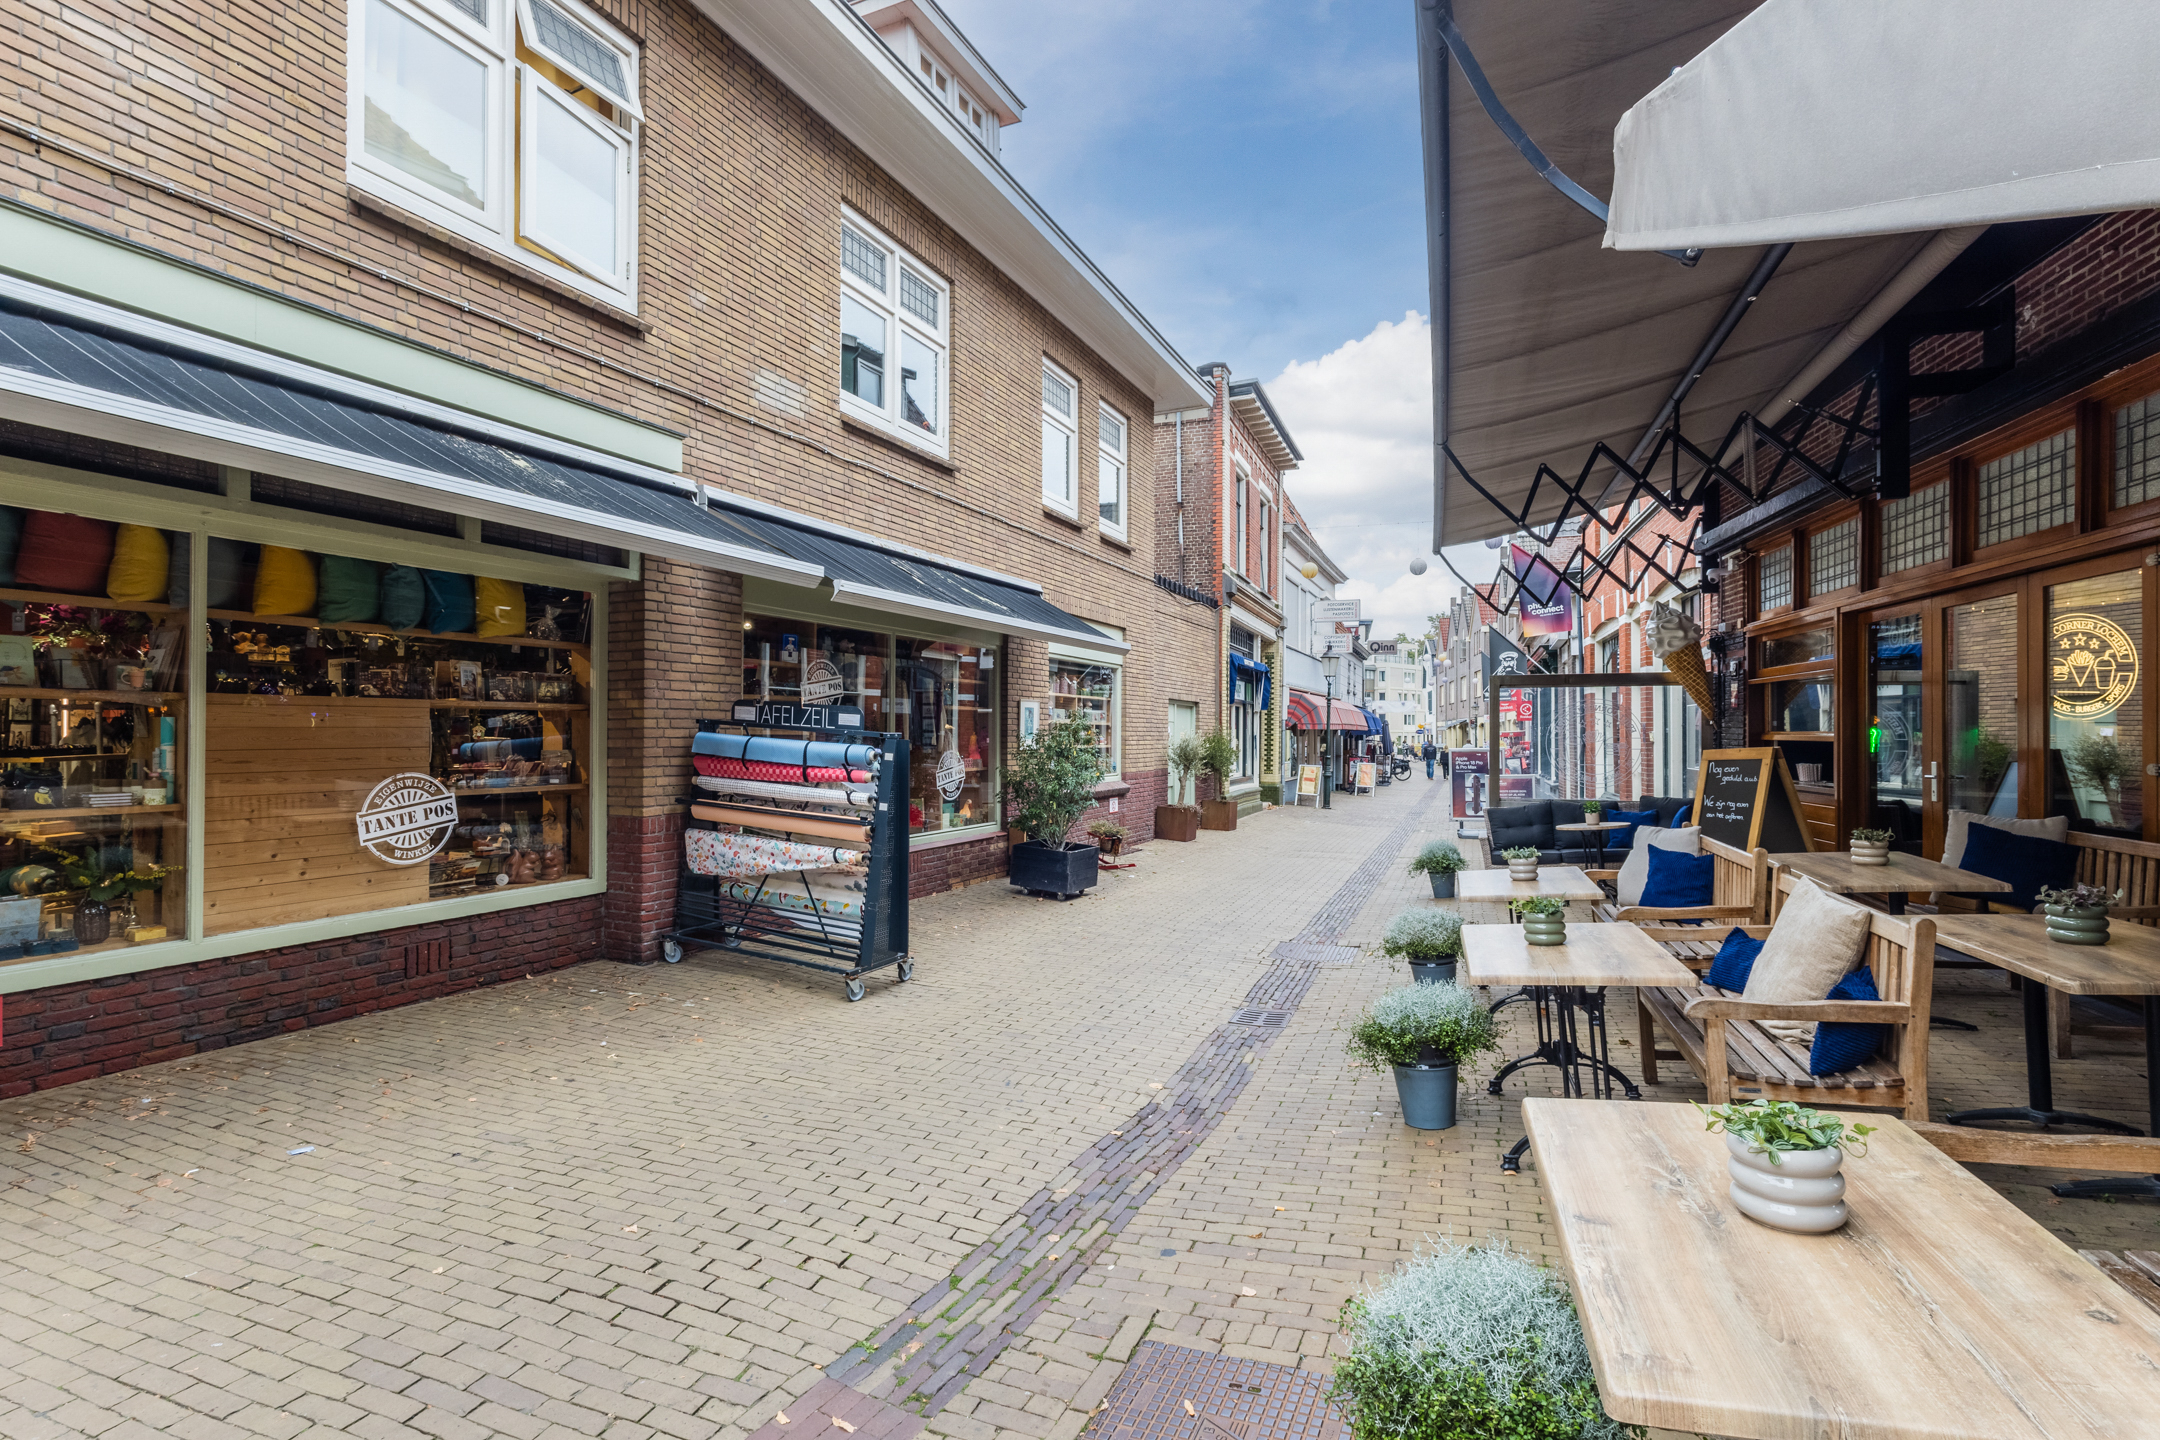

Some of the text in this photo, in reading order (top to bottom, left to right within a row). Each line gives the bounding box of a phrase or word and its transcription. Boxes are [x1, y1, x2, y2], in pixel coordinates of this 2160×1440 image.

[1531, 604, 1564, 615] connect
[2053, 620, 2129, 656] CORNER LOCHEM
[1370, 642, 1394, 653] Qinn
[828, 680, 842, 692] POS
[2076, 702, 2105, 713] BURGERS
[2105, 683, 2126, 704] SPORTS
[756, 704, 836, 729] TAFELZEIL
[938, 771, 953, 783] TANTE
[1709, 762, 1722, 778] Nog
[1720, 774, 1742, 785] geduld
[373, 779, 438, 805] EIGENWIJZE
[1704, 795, 1714, 806] We
[1726, 802, 1736, 810] nog
[361, 802, 454, 834] TANTE POS
[394, 843, 435, 858] WINKEL
